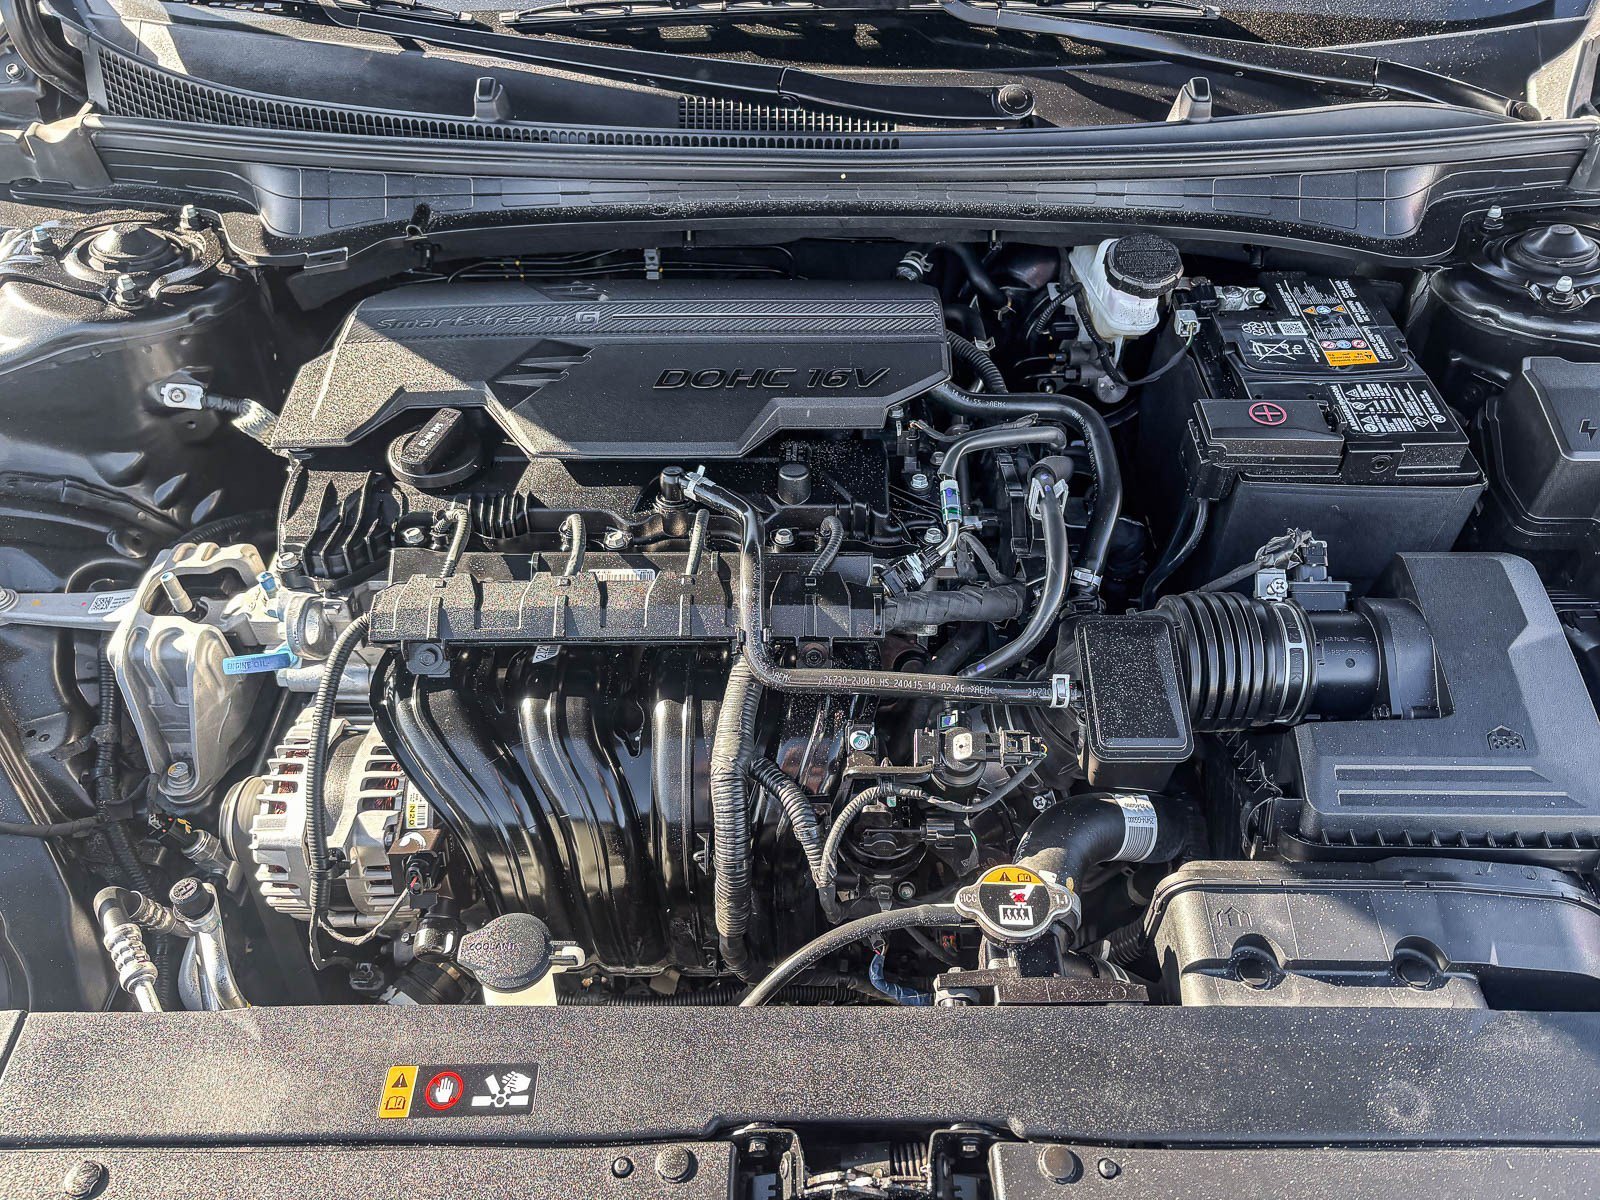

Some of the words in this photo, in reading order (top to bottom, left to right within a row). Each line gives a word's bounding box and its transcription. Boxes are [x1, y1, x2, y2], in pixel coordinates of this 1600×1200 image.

[377, 314, 566, 329] Smartstream
[576, 311, 600, 325] G
[652, 367, 797, 389] DOHC
[807, 367, 890, 388] 16V
[227, 660, 252, 670] ENGINE
[254, 660, 268, 668] OIL
[880, 678, 889, 687] HS
[893, 679, 923, 690] 240415
[960, 893, 977, 903] HCC
[1055, 893, 1068, 904] 1.1
